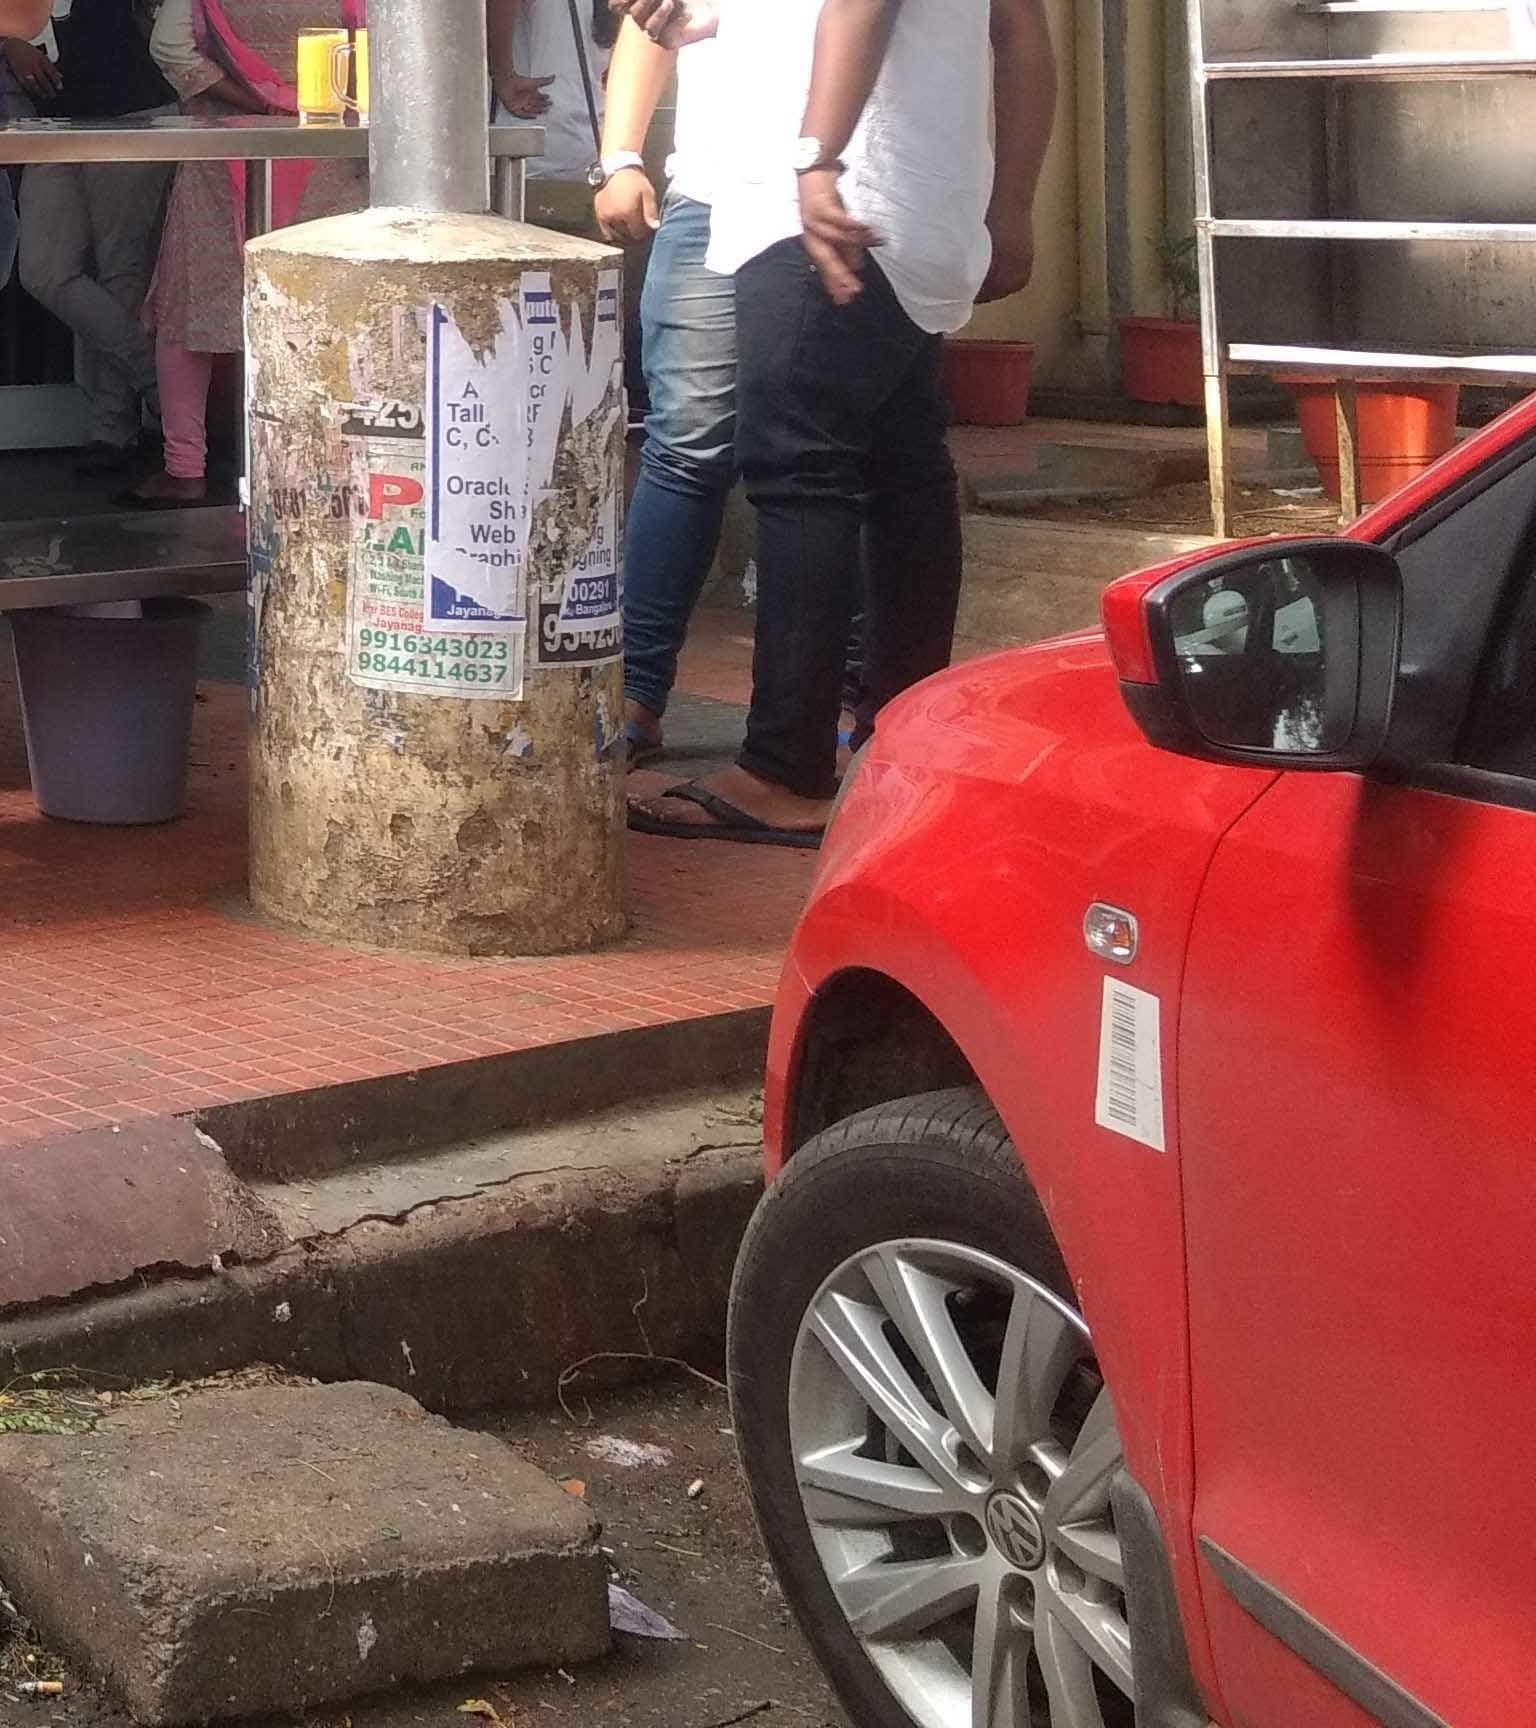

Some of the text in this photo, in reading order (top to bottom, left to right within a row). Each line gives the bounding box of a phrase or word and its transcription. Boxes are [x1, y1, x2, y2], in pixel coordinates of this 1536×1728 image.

[469, 524, 517, 546] Web
[358, 627, 509, 661] 9916343023
[357, 651, 508, 685] 9844114637
